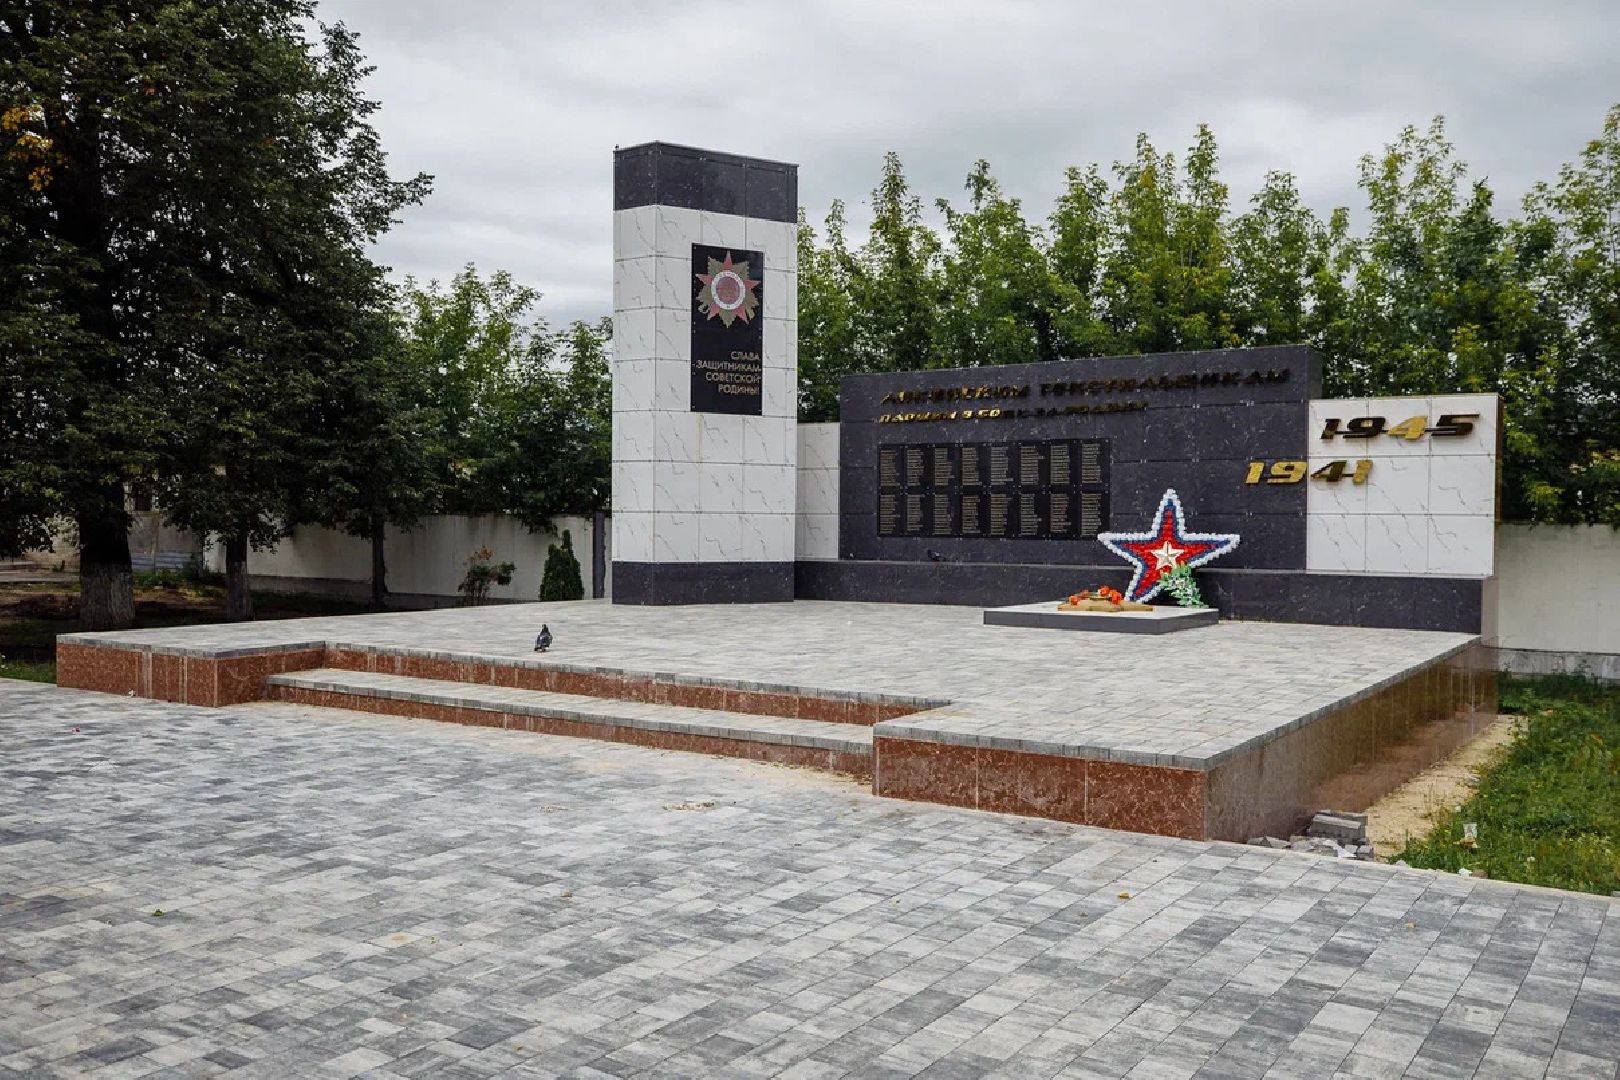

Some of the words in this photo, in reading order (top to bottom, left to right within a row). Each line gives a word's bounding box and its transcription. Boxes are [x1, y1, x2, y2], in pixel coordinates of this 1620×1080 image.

[730, 350, 760, 361] СЛАВА
[695, 359, 761, 373] ЗАЩИТНИКАМ
[705, 371, 761, 384] СОВЕТСКОЙ
[1320, 413, 1480, 440] 1945
[1246, 460, 1374, 485] 1941
